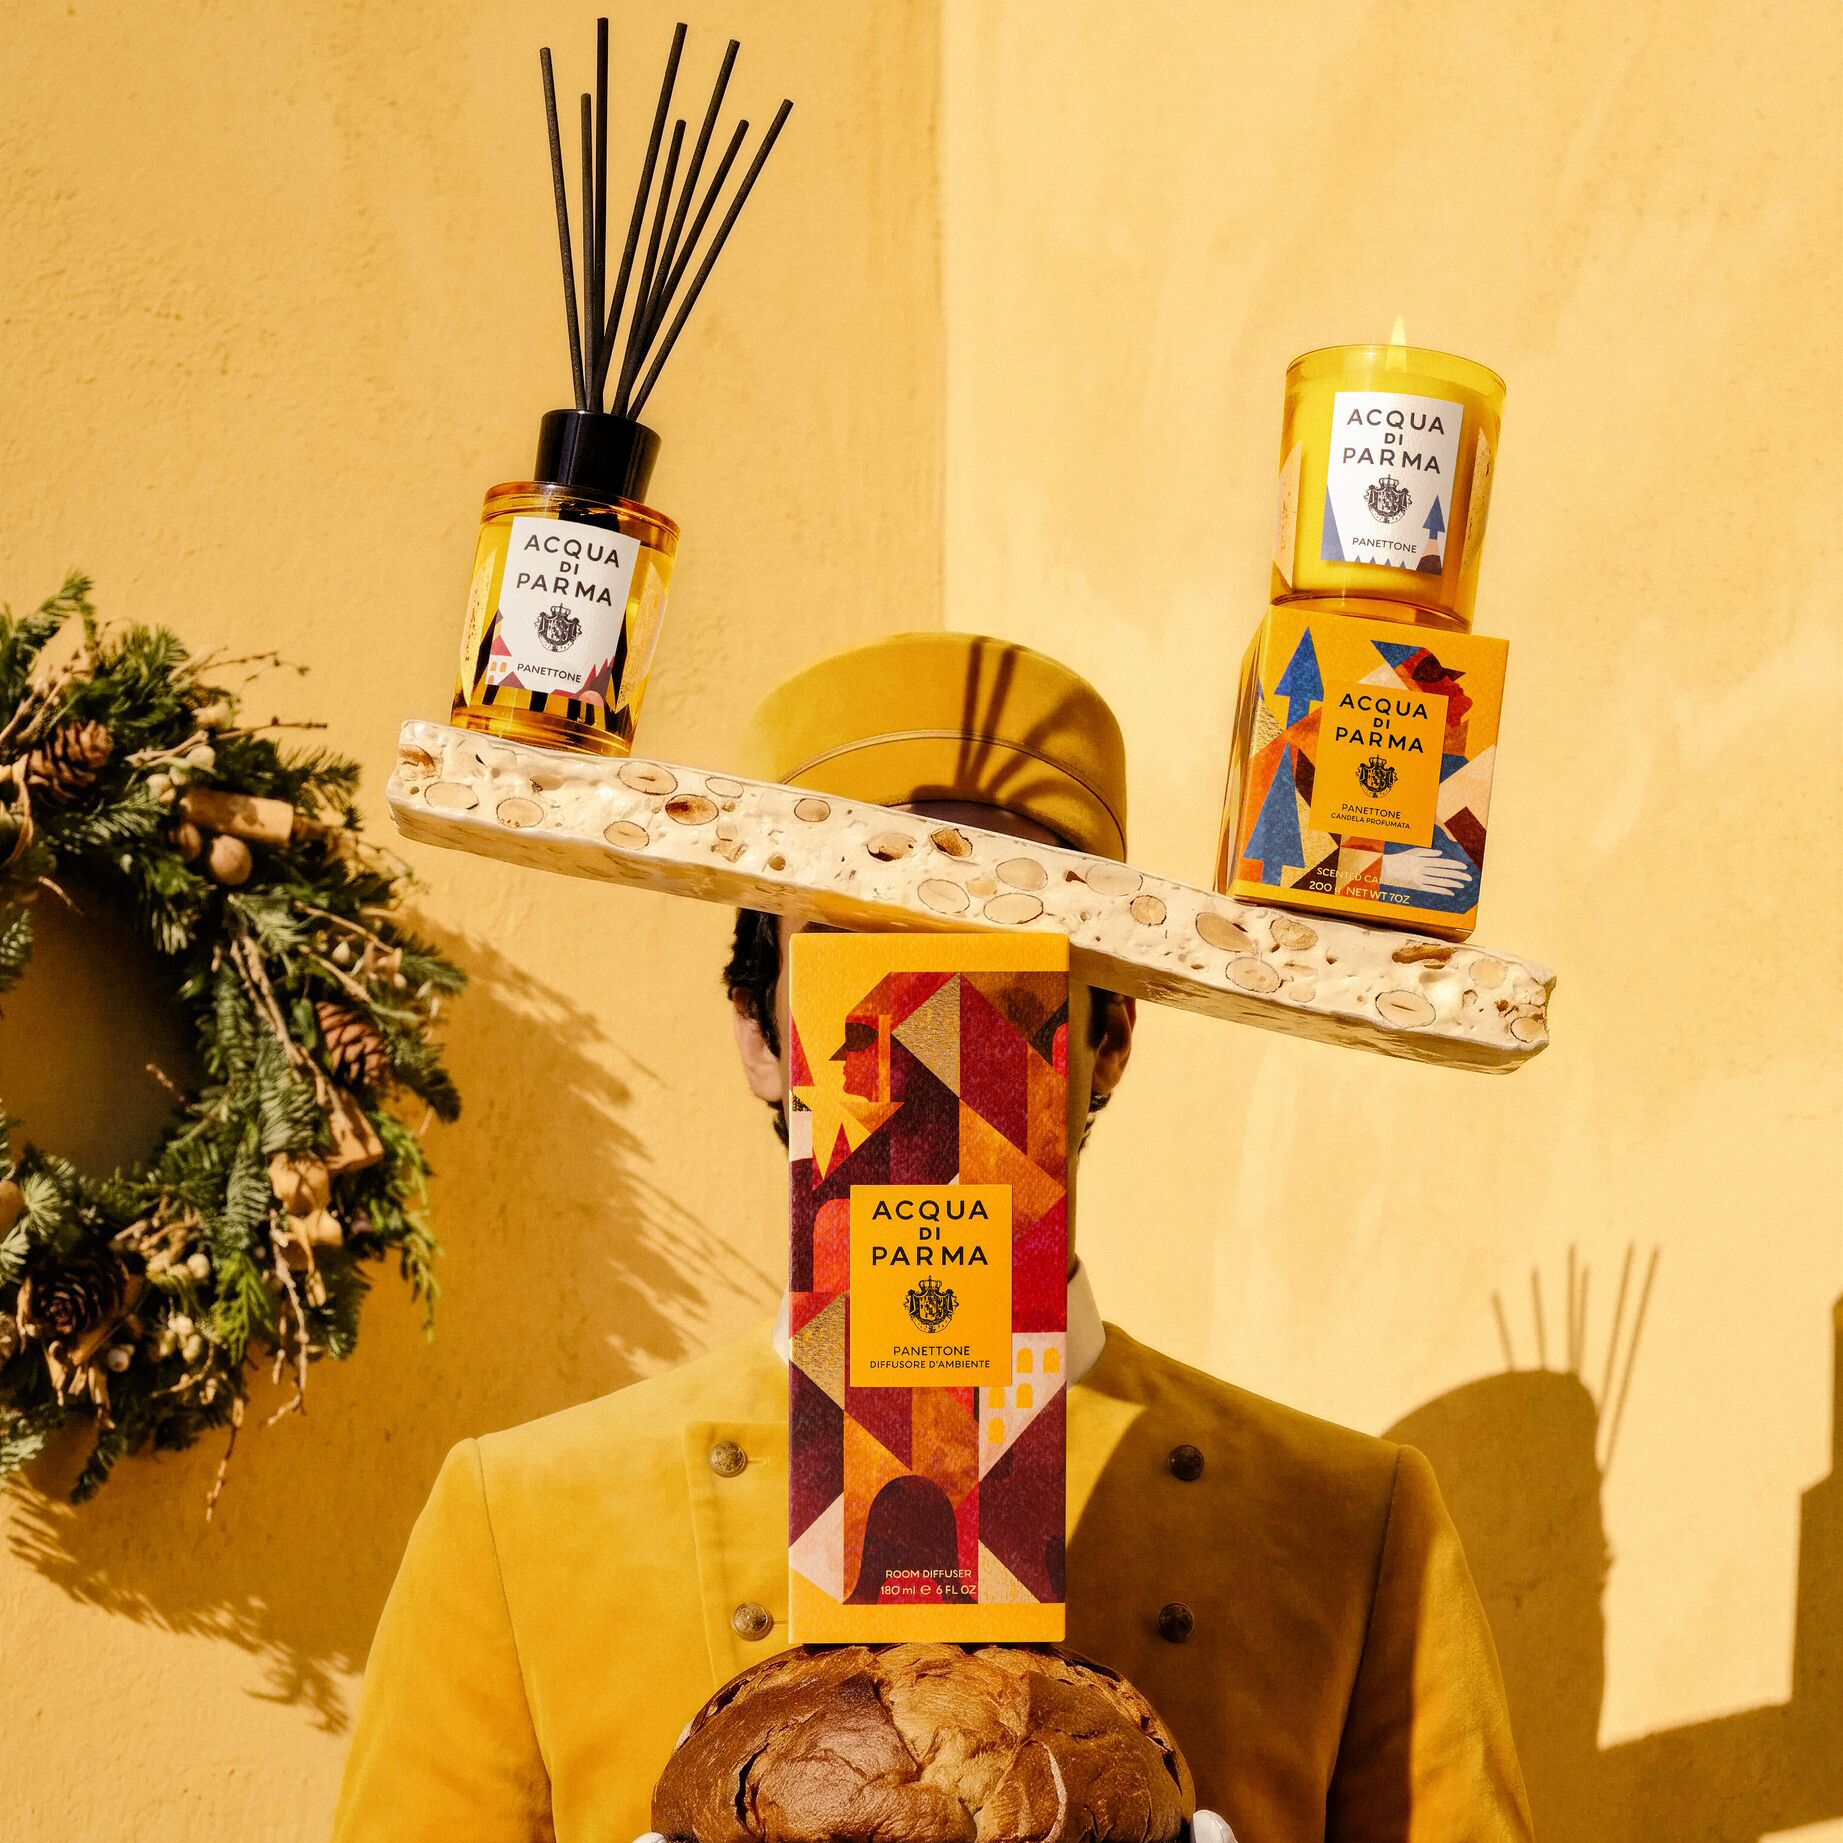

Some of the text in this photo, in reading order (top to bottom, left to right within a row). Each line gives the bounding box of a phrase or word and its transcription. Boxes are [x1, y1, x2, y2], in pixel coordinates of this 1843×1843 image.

[1346, 408, 1445, 435] ACQUA
[1383, 432, 1403, 446] DI
[1342, 447, 1441, 474] PARMA
[523, 534, 620, 569] ACQUA
[1352, 537, 1417, 553] PANETTONE
[559, 560, 579, 575] DI
[516, 572, 613, 607] PARMA
[517, 663, 582, 683] PANETTONE
[1339, 693, 1428, 719] ACQUA
[1373, 718, 1390, 730] DI
[1335, 727, 1424, 753] PARMA
[1341, 803, 1402, 819] PANETTONE
[1330, 812, 1411, 829] CANDELA PROFUMATA
[1316, 867, 1362, 881] SCENTED
[1309, 880, 1333, 892] 200
[1346, 886, 1369, 898] NET
[1370, 889, 1389, 900] WT
[871, 1199, 989, 1222] ACQUA
[919, 1226, 941, 1241] DI
[872, 1246, 989, 1266] PARMA
[893, 1346, 970, 1356] PANETTONE
[870, 1360, 990, 1369] DIFFUSORE D'AMBIENTE
[885, 1569, 972, 1579] ROOM DIFFUSER
[880, 1585, 900, 1595] 180
[902, 1585, 916, 1595] ml
[936, 1585, 943, 1595] 6
[945, 1585, 958, 1595] FL
[960, 1585, 977, 1595] OZ
